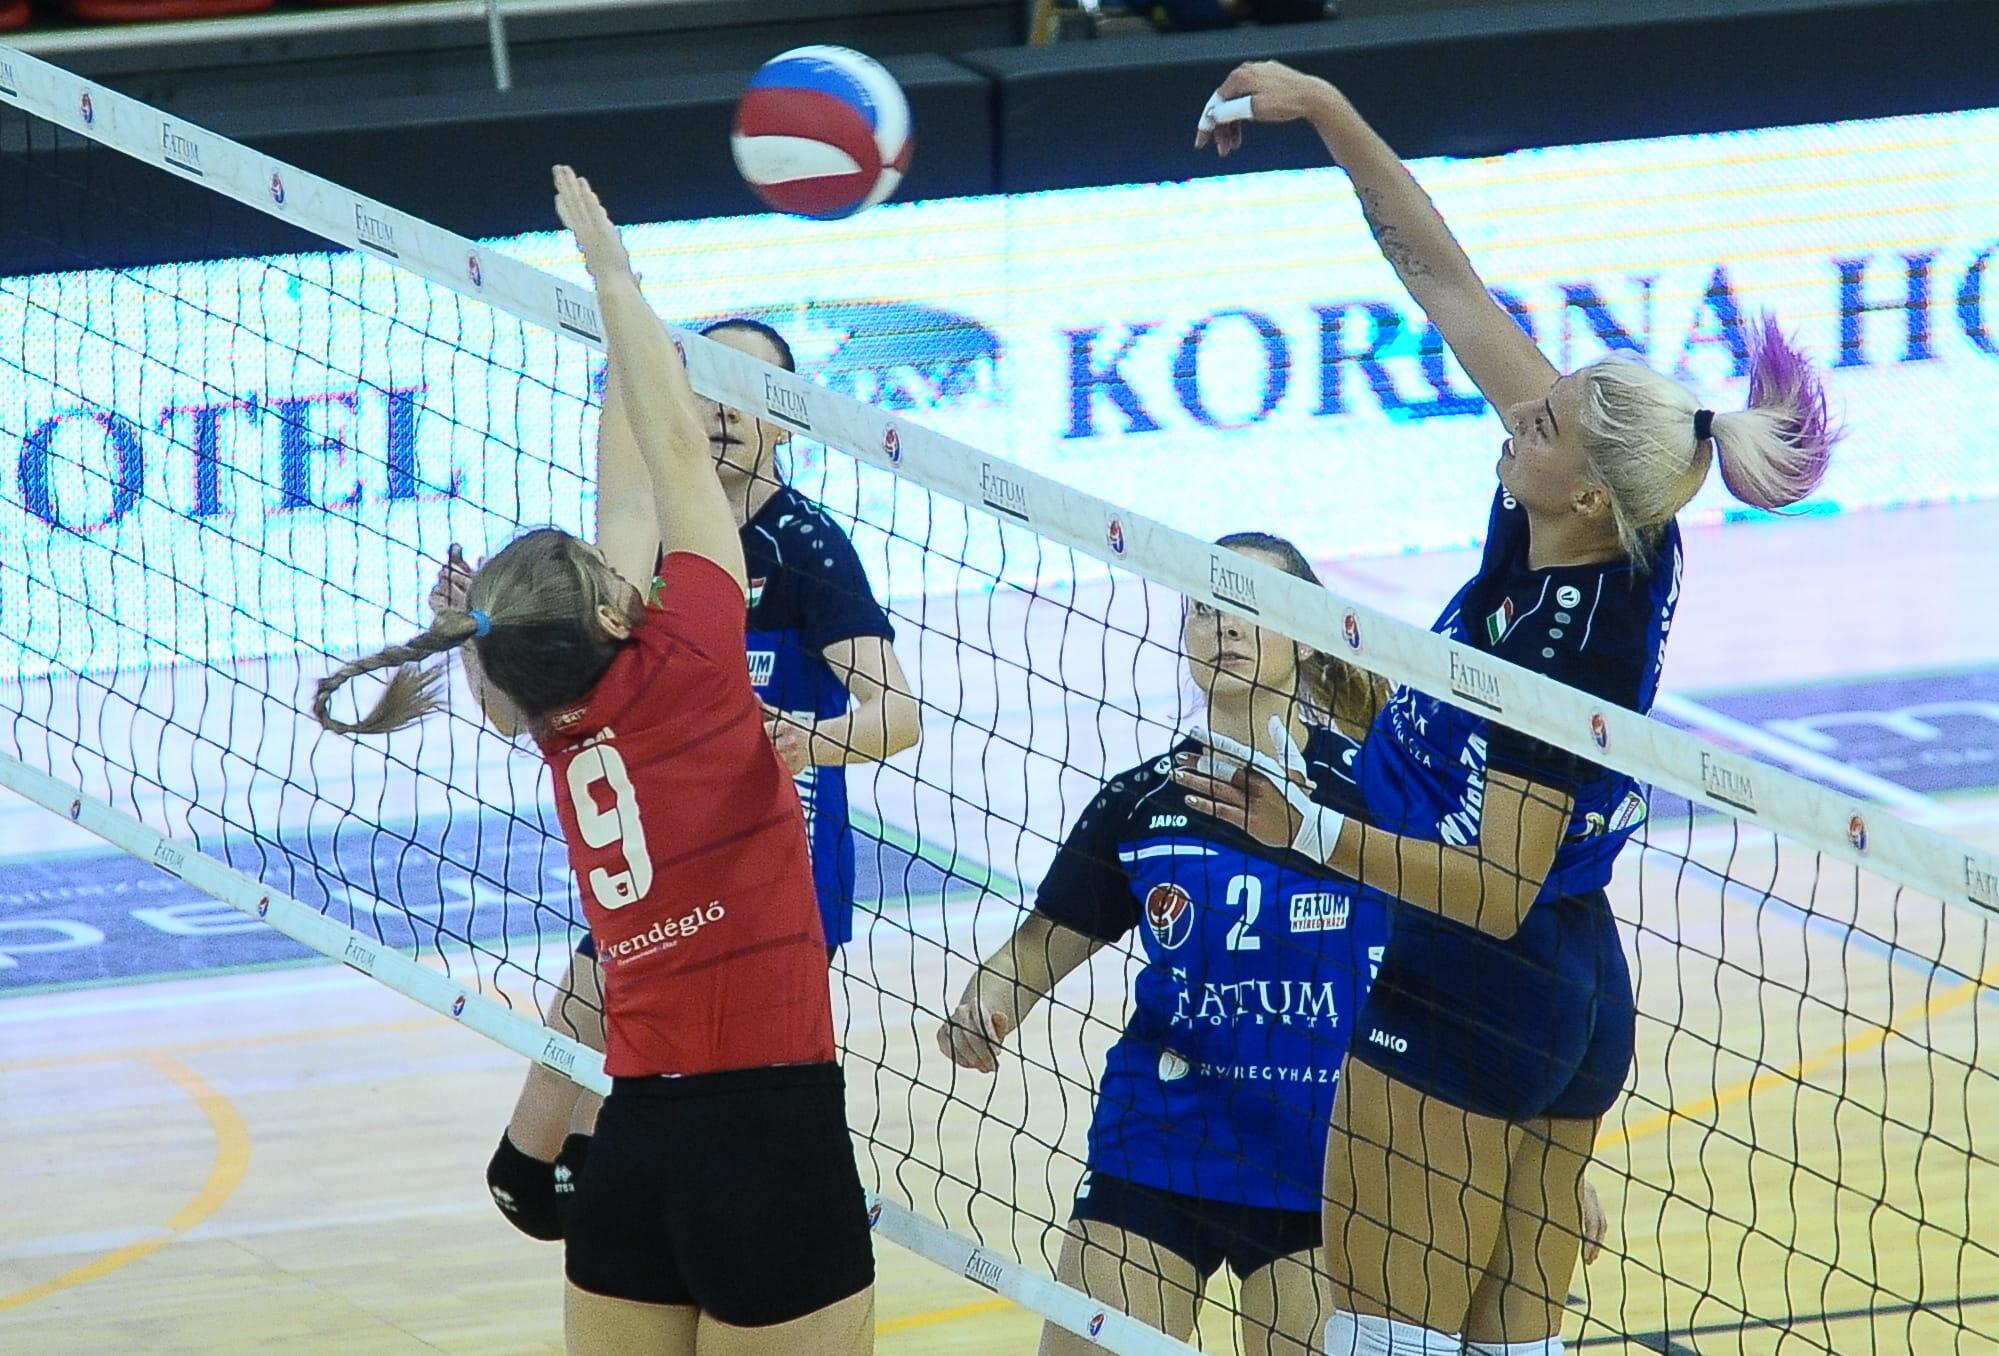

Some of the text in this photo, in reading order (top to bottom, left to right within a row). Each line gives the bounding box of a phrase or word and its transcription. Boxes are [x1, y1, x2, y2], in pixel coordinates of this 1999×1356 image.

[354, 203, 394, 242] FATUM
[17, 384, 464, 534] OTEL
[982, 461, 1026, 507] FATUM
[1210, 553, 1256, 600] FATUM
[1450, 650, 1500, 698] FATUM
[1701, 751, 1753, 800] FATUM
[566, 744, 653, 910] 9
[1149, 815, 1188, 829] JAKO
[608, 900, 725, 958] vendéglő
[1226, 874, 1261, 950] 2
[1293, 895, 1346, 918] FATUM
[966, 1248, 1003, 1282] FATUM
